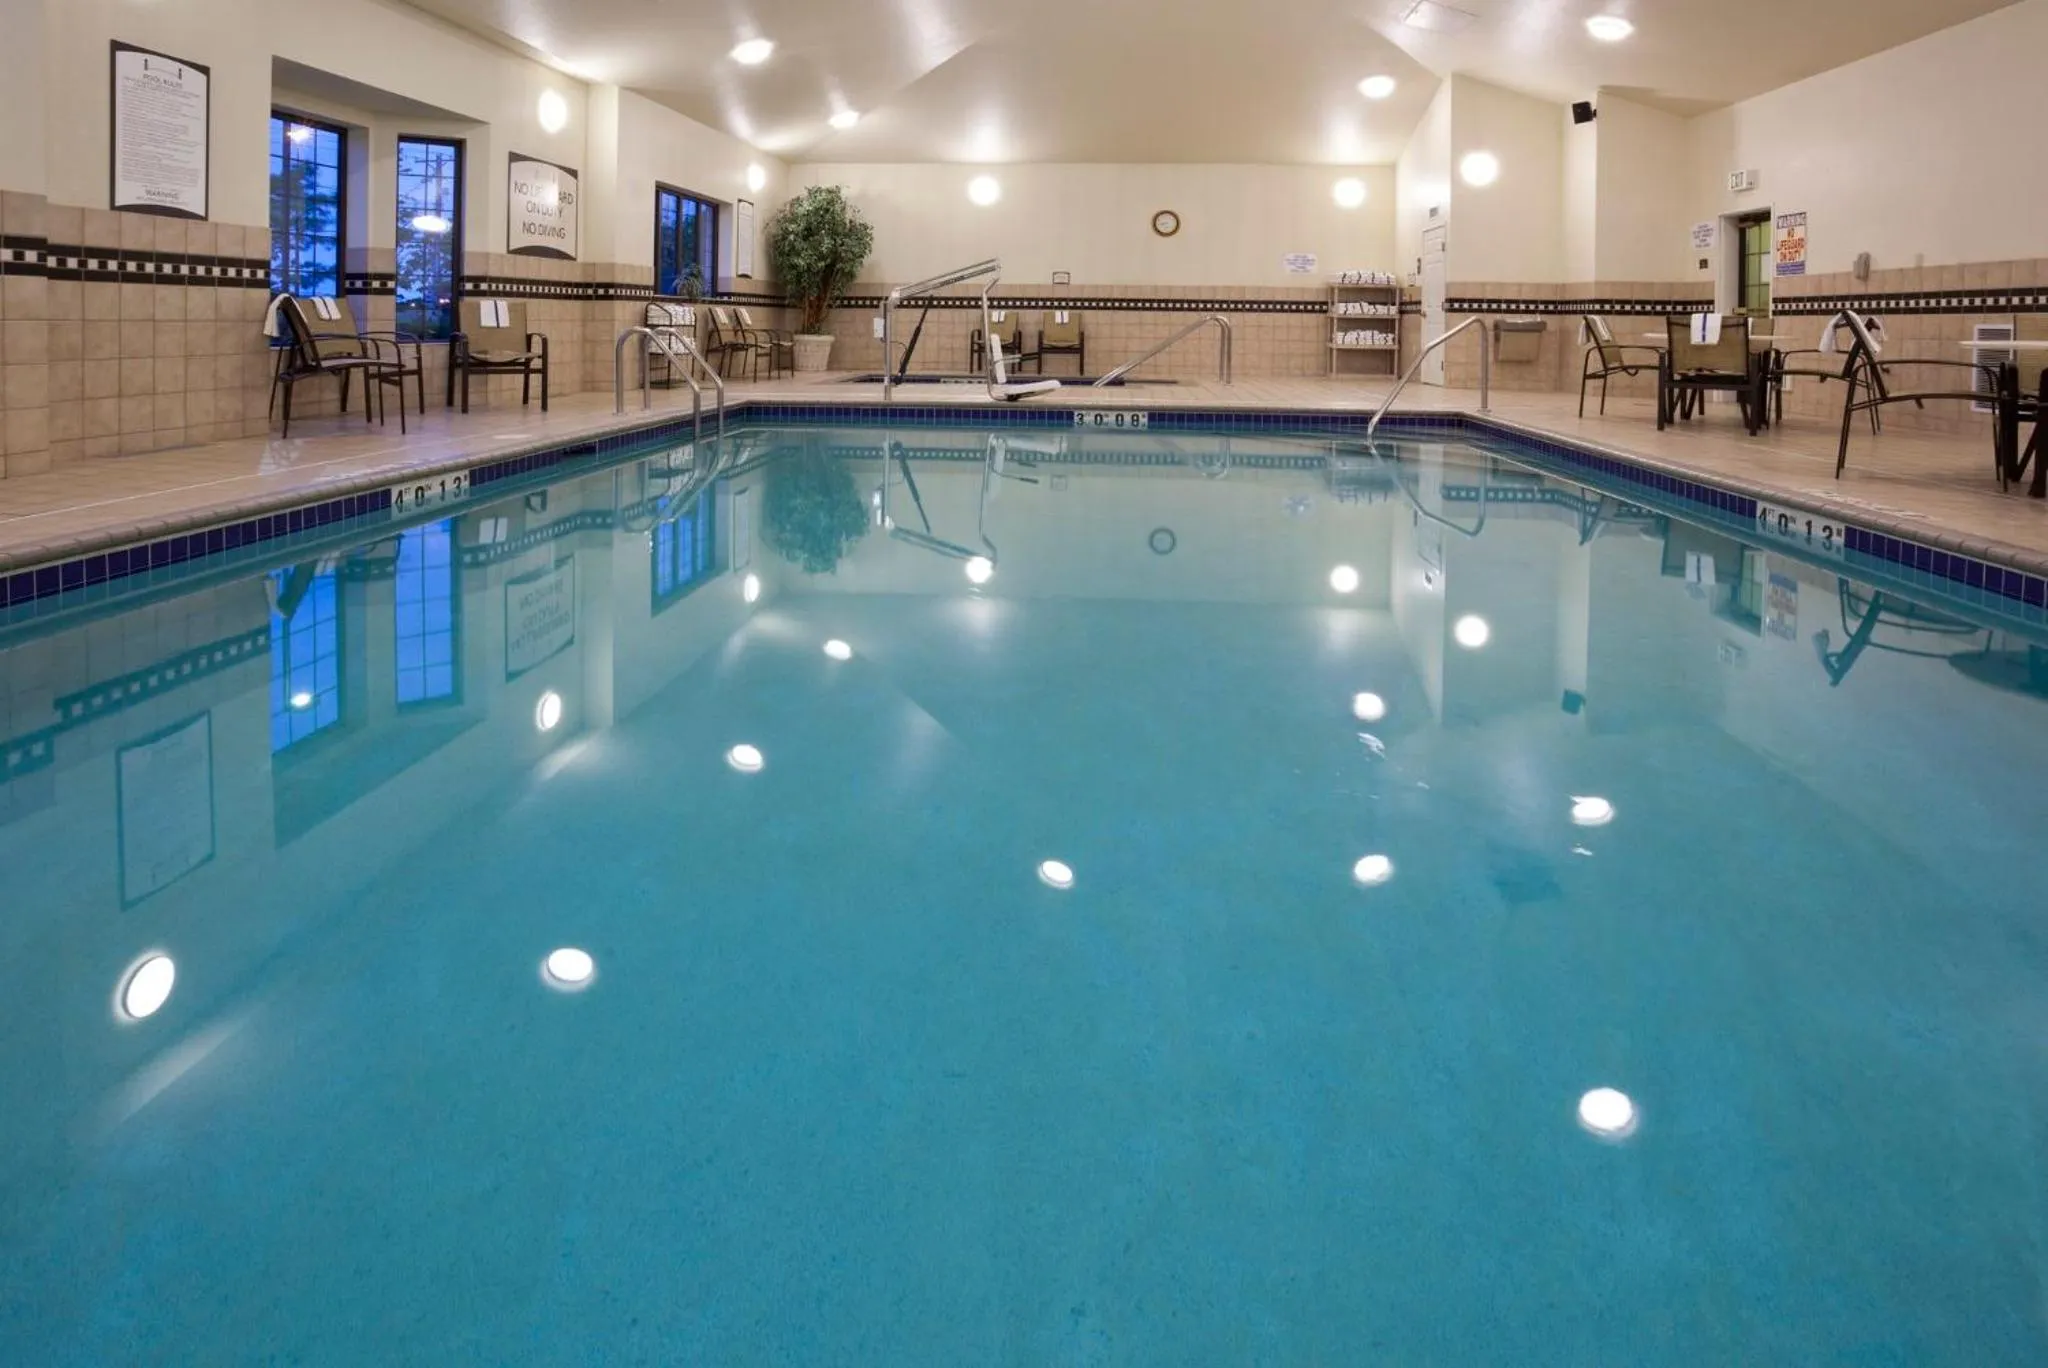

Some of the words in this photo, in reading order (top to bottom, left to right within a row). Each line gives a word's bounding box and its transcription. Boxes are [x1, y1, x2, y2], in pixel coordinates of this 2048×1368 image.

[514, 181, 529, 195] NO
[526, 200, 540, 214] ON
[522, 221, 537, 235] NO
[538, 223, 566, 239] DIVING
